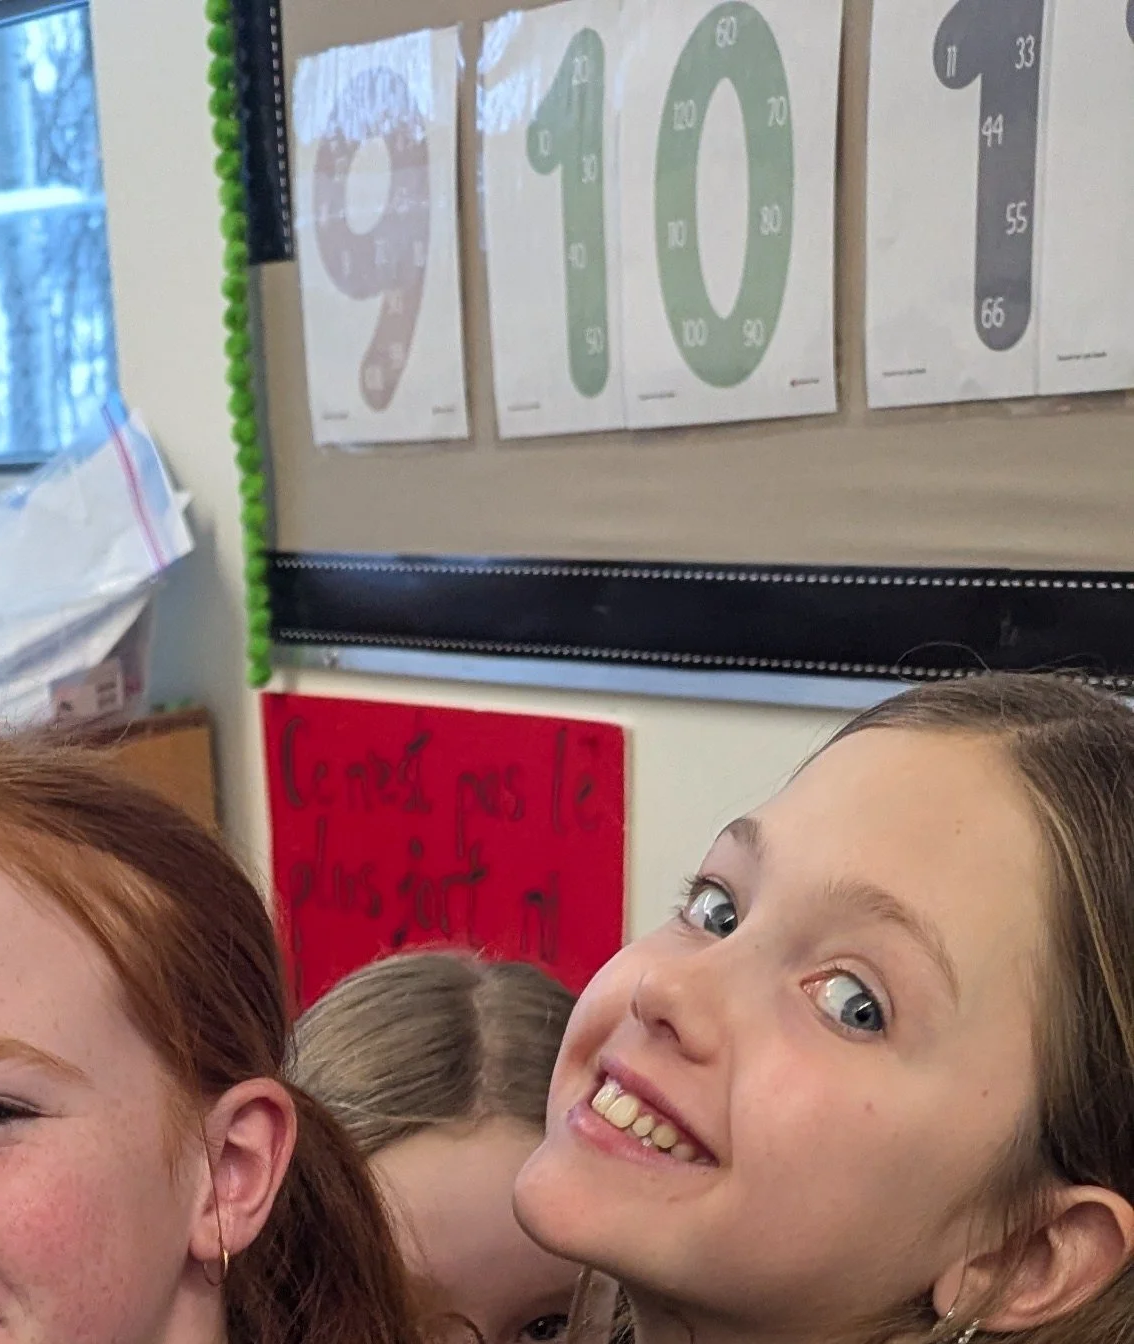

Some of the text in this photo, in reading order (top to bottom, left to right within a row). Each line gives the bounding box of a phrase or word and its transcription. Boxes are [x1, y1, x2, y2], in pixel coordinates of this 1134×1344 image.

[716, 15, 738, 47] 60
[946, 44, 958, 78] 11
[1015, 34, 1036, 70] 33
[673, 99, 697, 131] 120
[767, 96, 788, 127] 70
[981, 113, 1005, 148] 44
[759, 204, 783, 236] 80
[1005, 200, 1028, 236] 55
[980, 296, 1006, 330] 66
[584, 325, 604, 356] 50
[681, 317, 711, 348] 100
[742, 317, 767, 349] 90
